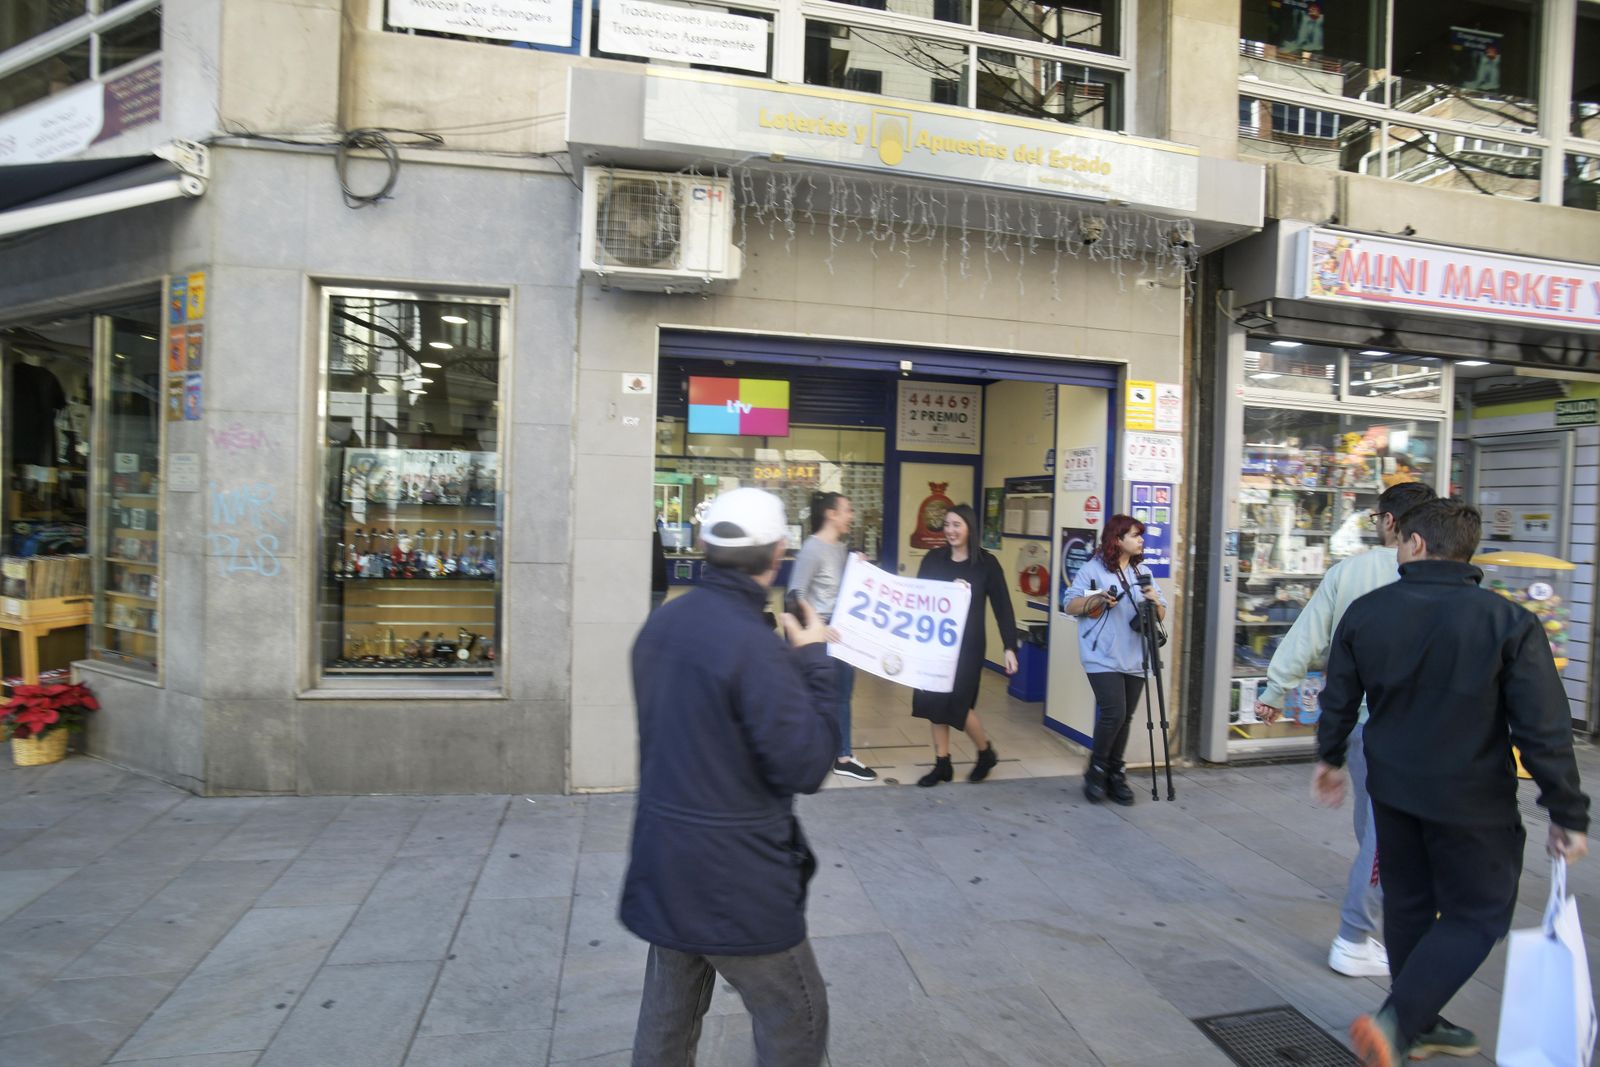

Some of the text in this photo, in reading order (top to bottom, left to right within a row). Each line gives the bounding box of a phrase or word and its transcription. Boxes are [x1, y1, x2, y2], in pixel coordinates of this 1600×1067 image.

[619, 4, 702, 26] Traducciones
[611, 21, 679, 40] Traduction
[854, 123, 868, 146] y
[914, 128, 1009, 161] Apuestas
[1013, 143, 1043, 166] del
[1048, 148, 1112, 176] Estado
[1338, 248, 1431, 297] MINI
[1440, 263, 1584, 312] MARKET
[908, 392, 971, 410] 44469
[920, 410, 969, 424] PREMIO
[879, 583, 952, 614] PREMIO
[848, 590, 958, 648] 25296
